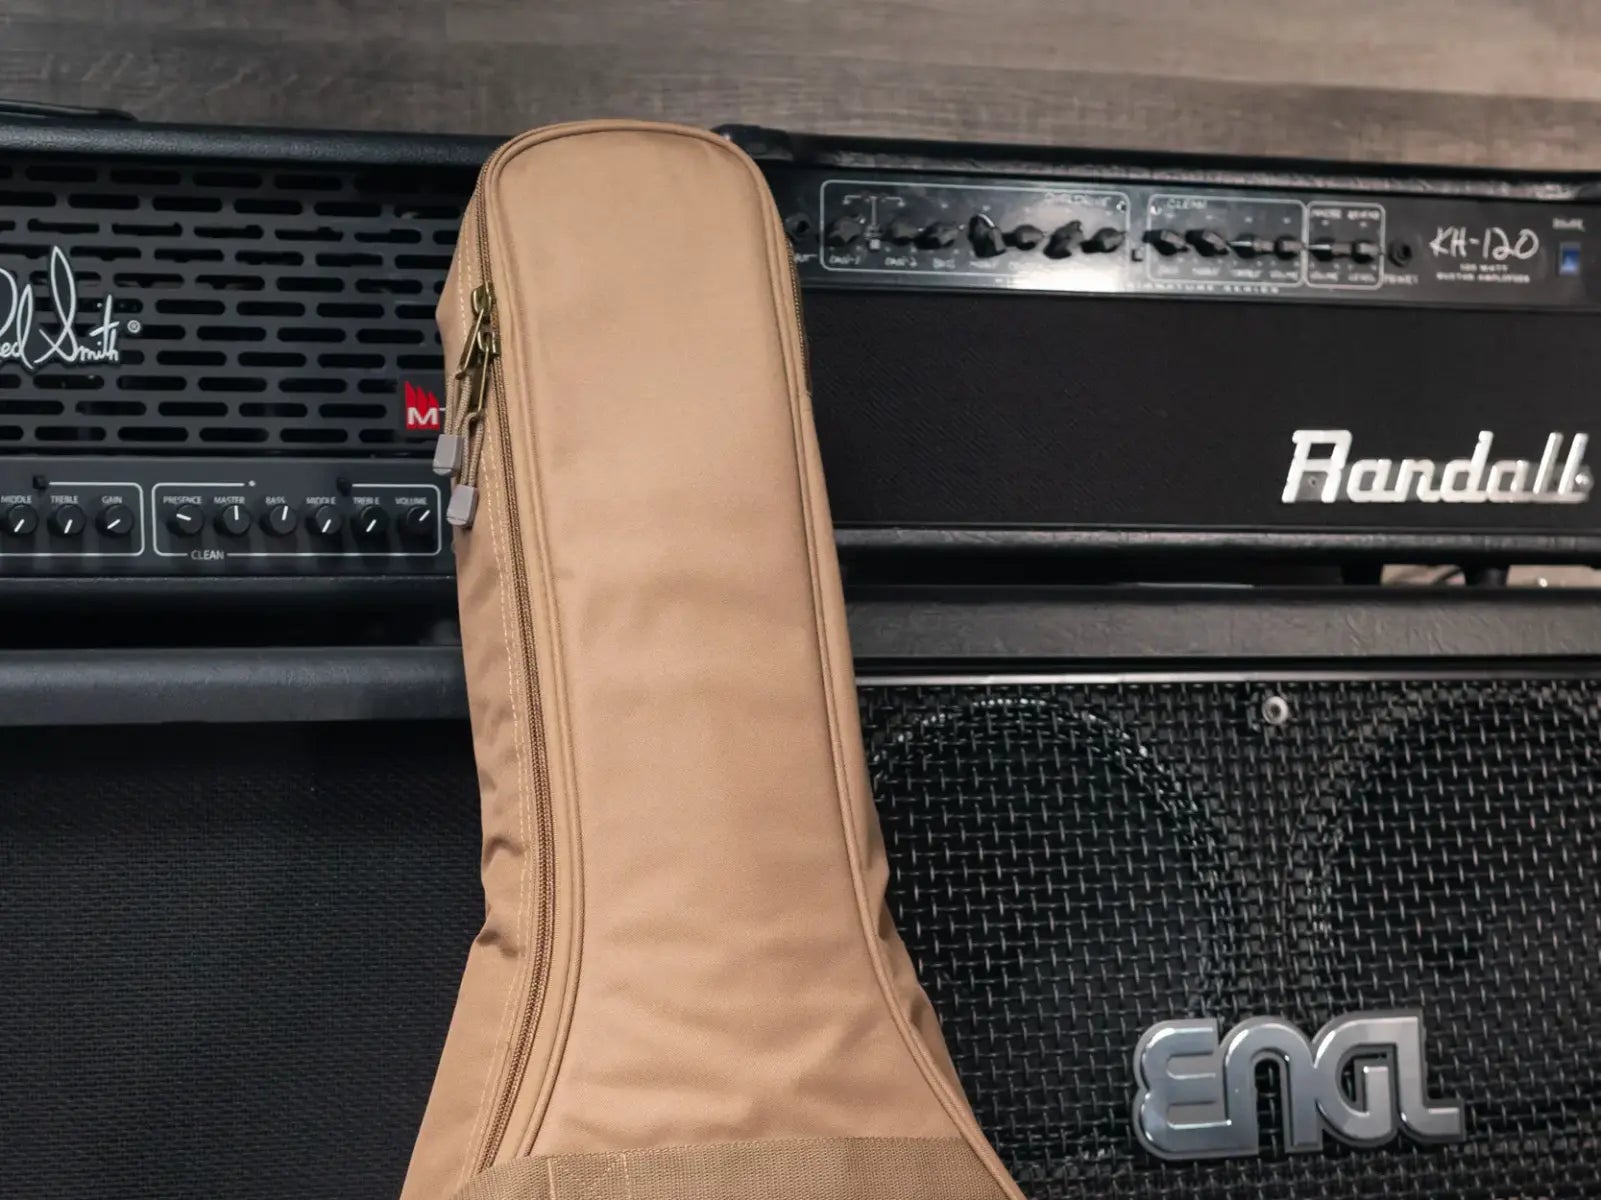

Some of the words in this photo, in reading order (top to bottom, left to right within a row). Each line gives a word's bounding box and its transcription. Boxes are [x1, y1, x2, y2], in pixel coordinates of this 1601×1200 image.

[1428, 225, 1540, 261] KH-120
[33, 245, 120, 363] Smith
[1281, 429, 1590, 503] Randall
[1, 495, 32, 505] MIDDLE
[51, 495, 78, 505] TREBLE
[101, 495, 123, 505] GAIN
[213, 496, 245, 505] MASTER
[265, 496, 286, 505] BASS
[190, 549, 225, 561] CLEAN
